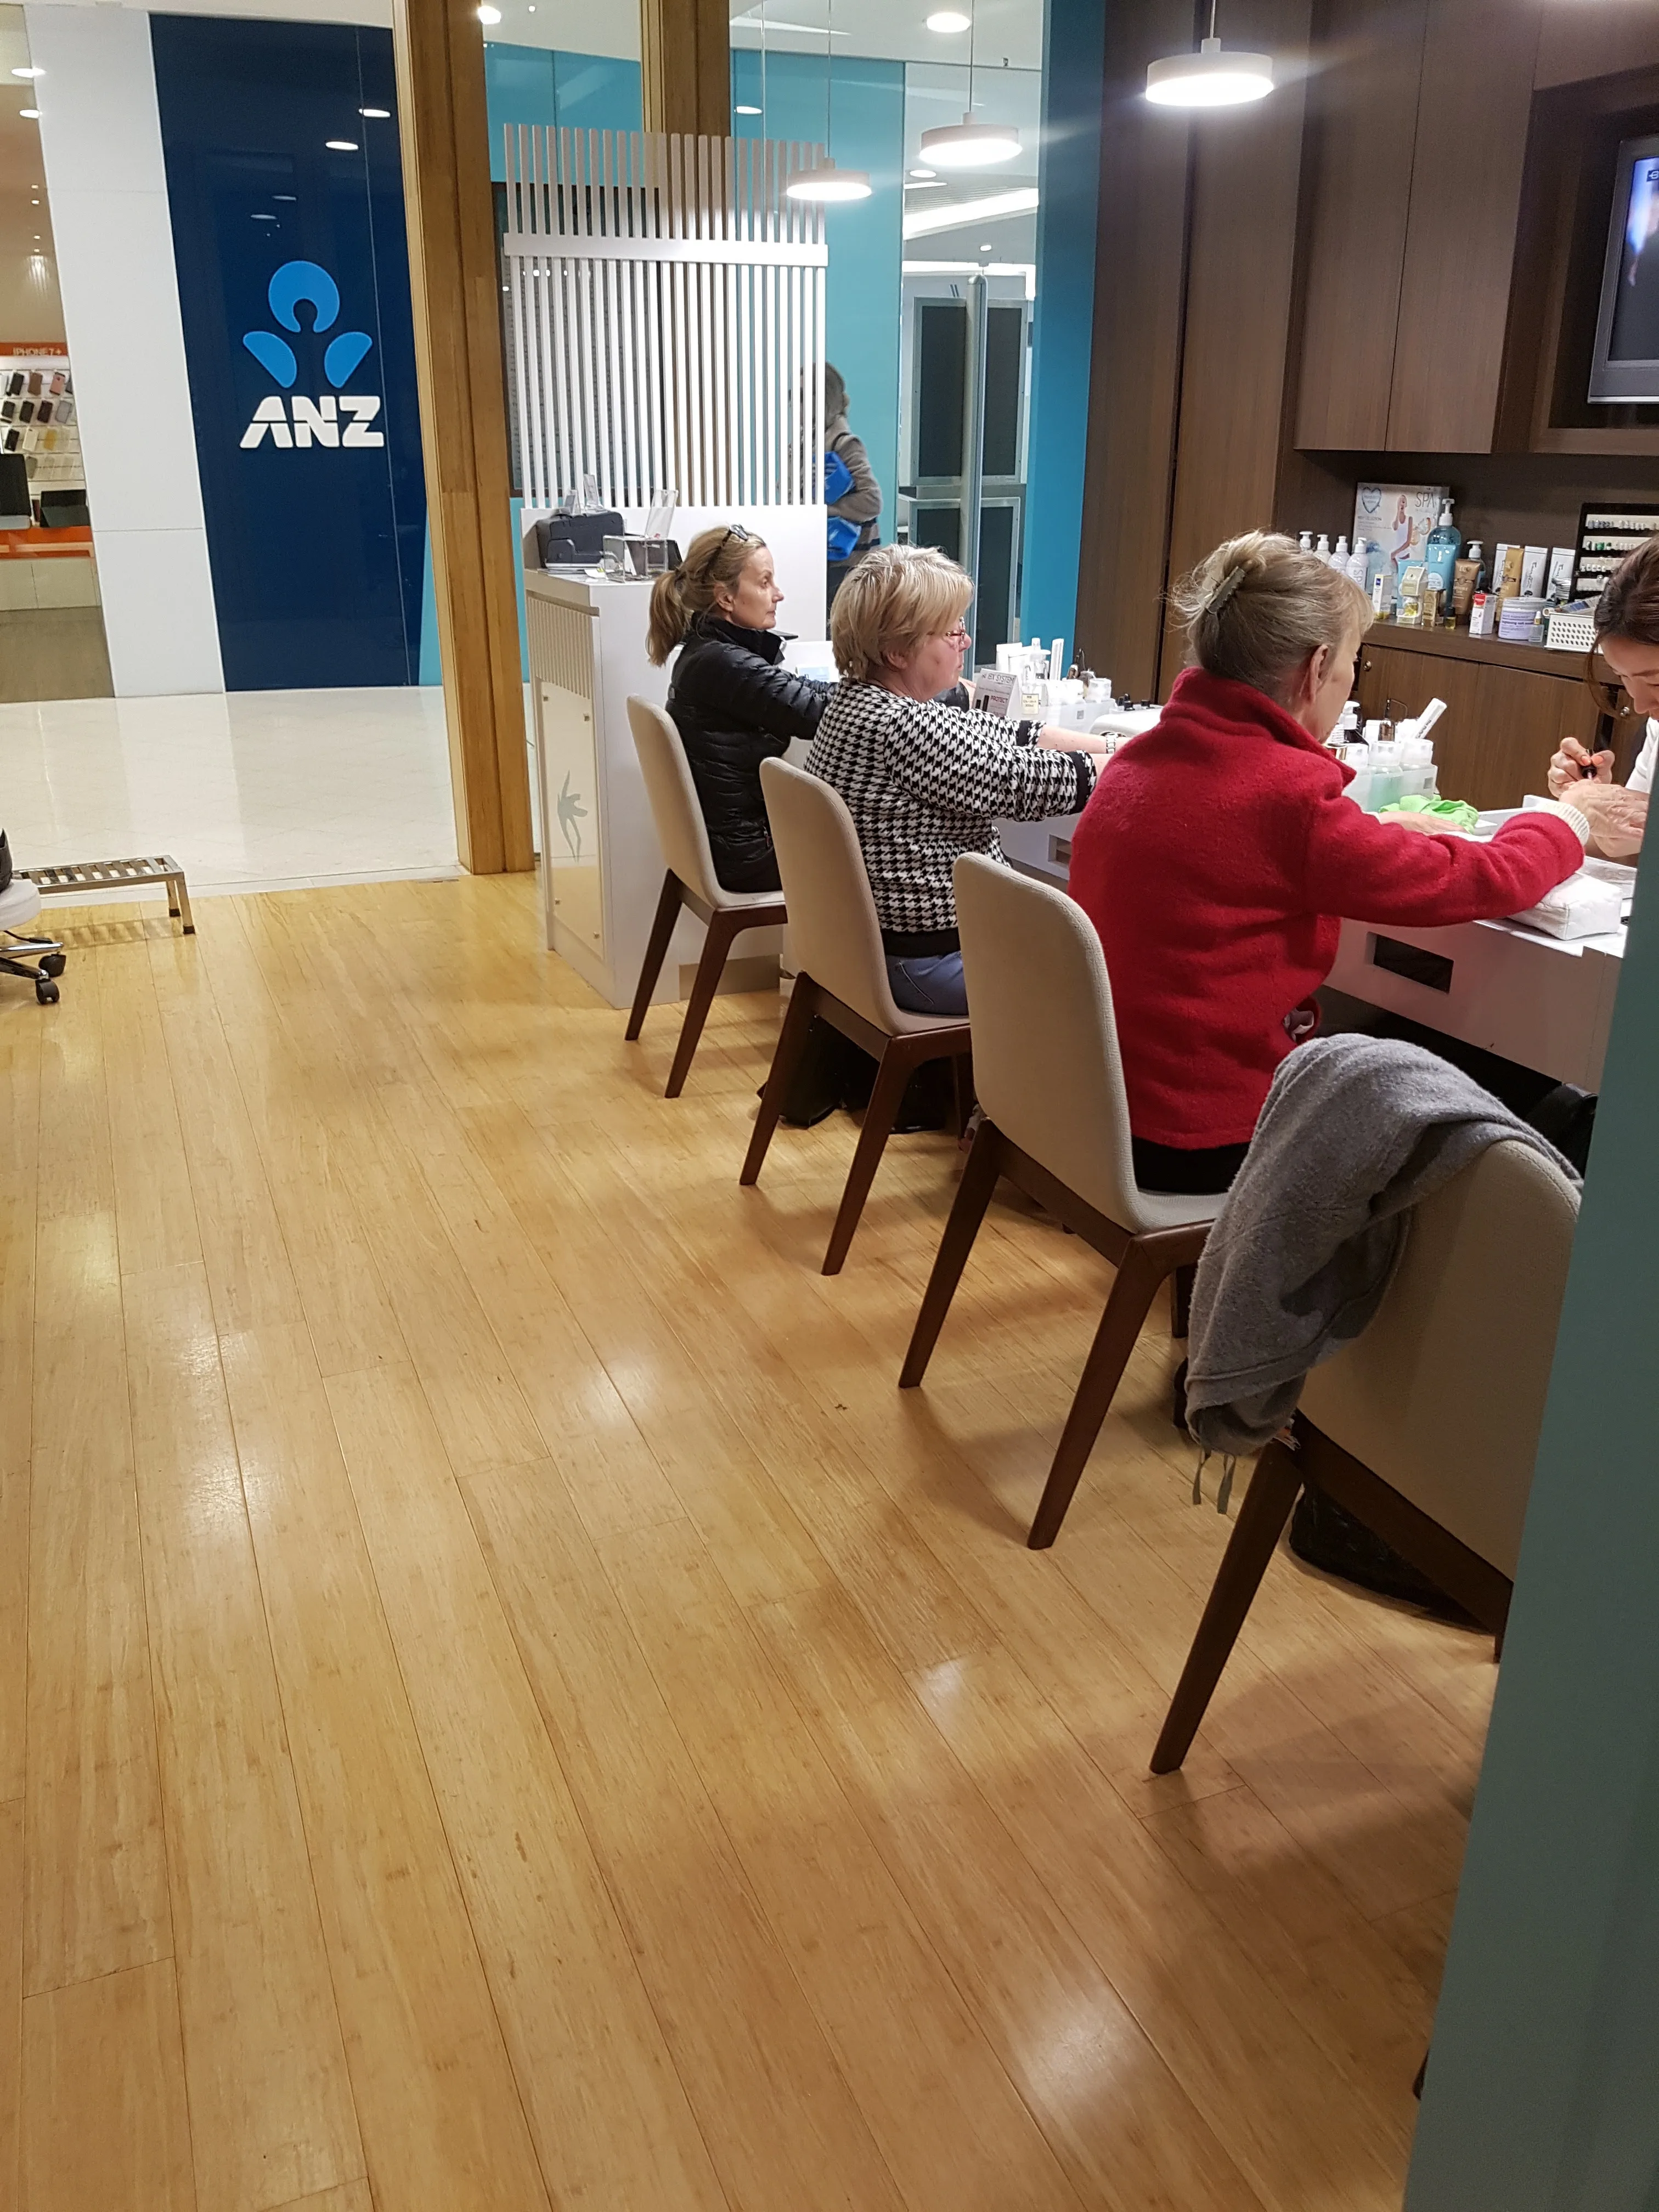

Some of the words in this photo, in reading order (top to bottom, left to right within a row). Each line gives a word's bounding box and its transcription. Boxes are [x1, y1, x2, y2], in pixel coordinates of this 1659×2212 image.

[240, 396, 384, 448] ANZ
[1415, 492, 1435, 508] SPA
[996, 674, 1015, 684] SYSTEM
[991, 695, 1008, 703] PROTECT
